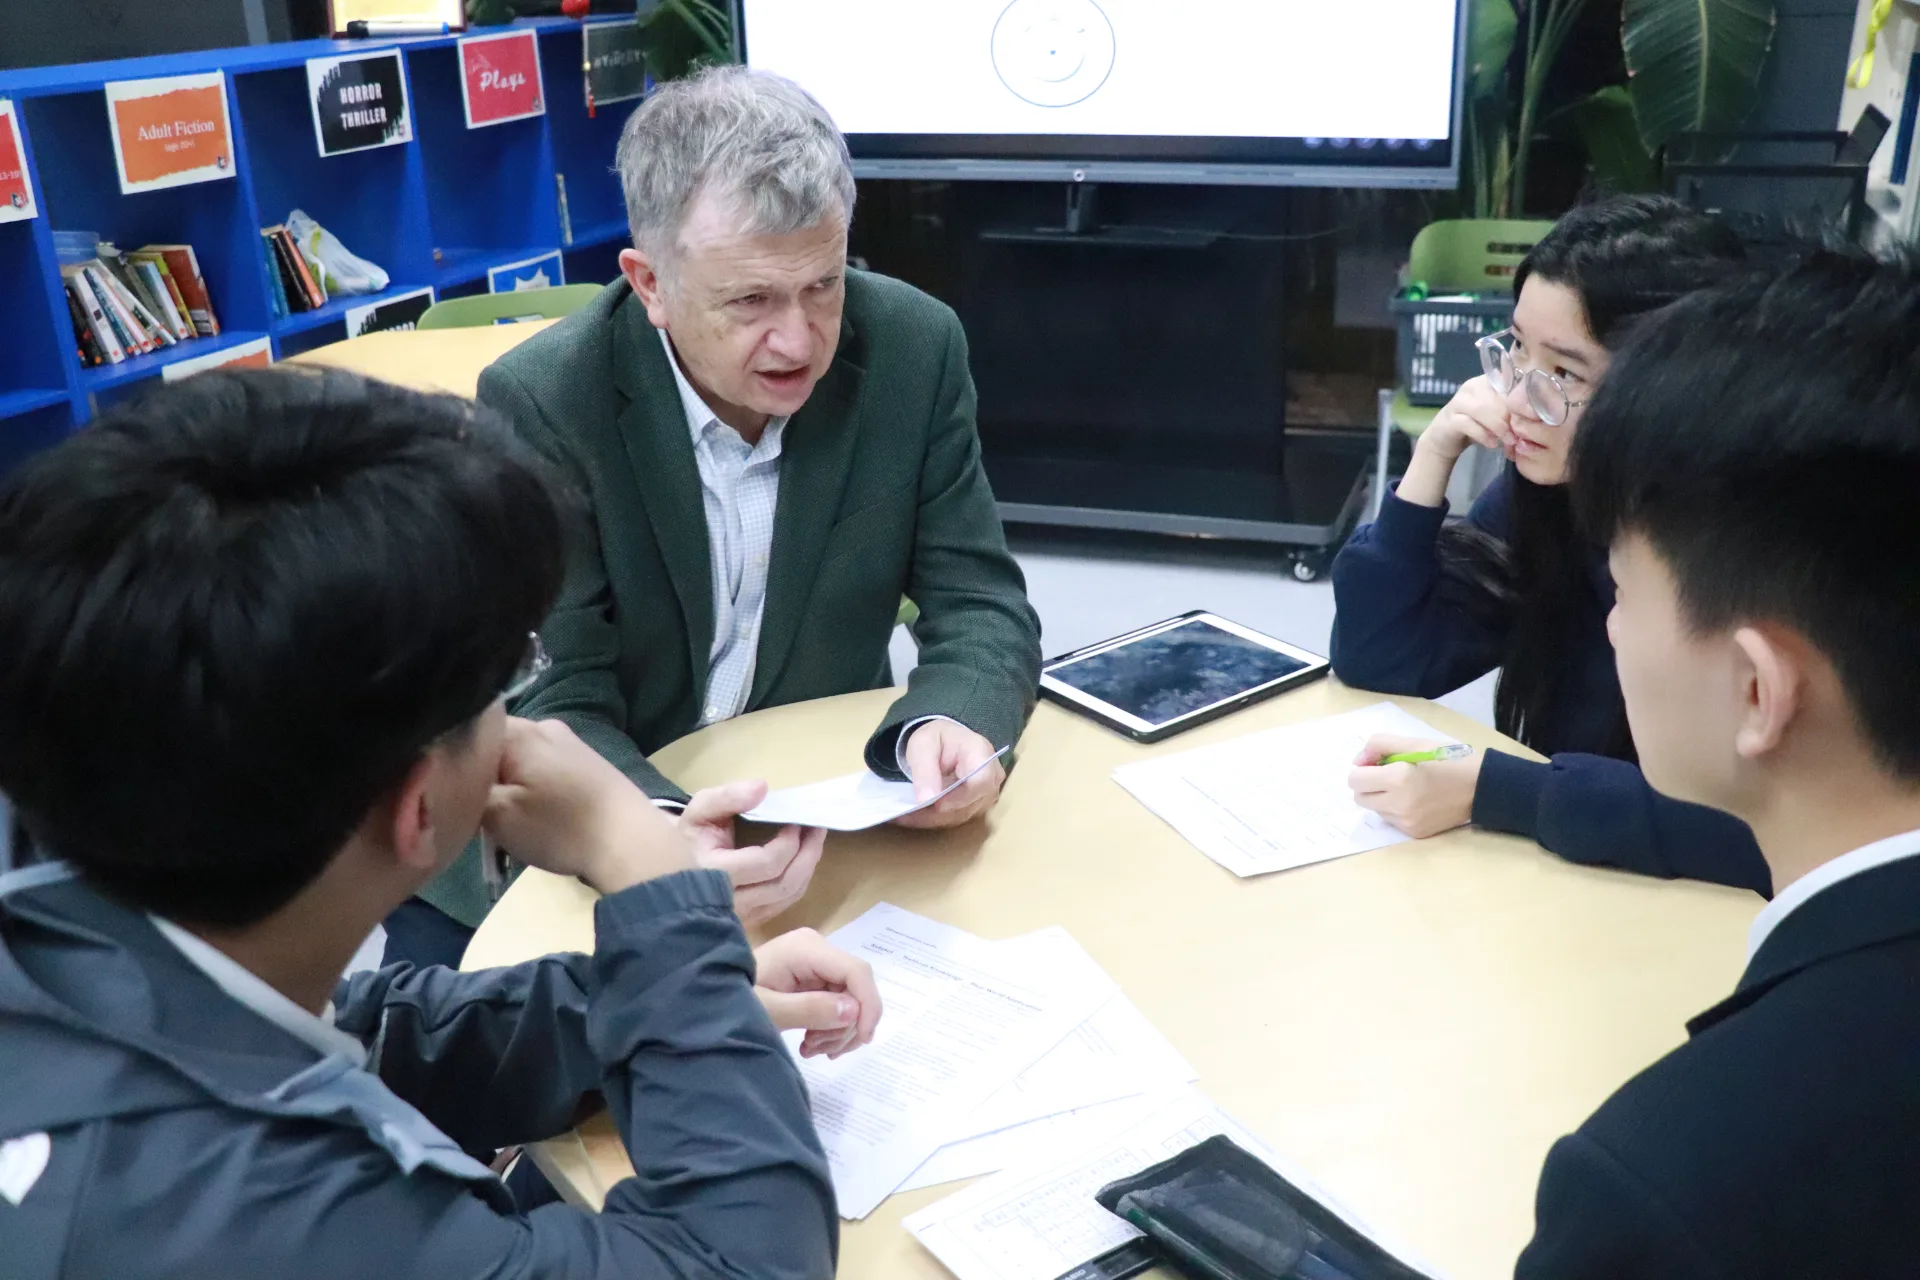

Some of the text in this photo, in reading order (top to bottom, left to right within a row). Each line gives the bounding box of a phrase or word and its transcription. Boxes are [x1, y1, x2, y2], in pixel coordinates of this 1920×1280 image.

[480, 69, 526, 92] Plays
[340, 82, 383, 105] HORROR
[138, 119, 215, 141] Adult Fiction
[340, 106, 388, 131] THRILLER
